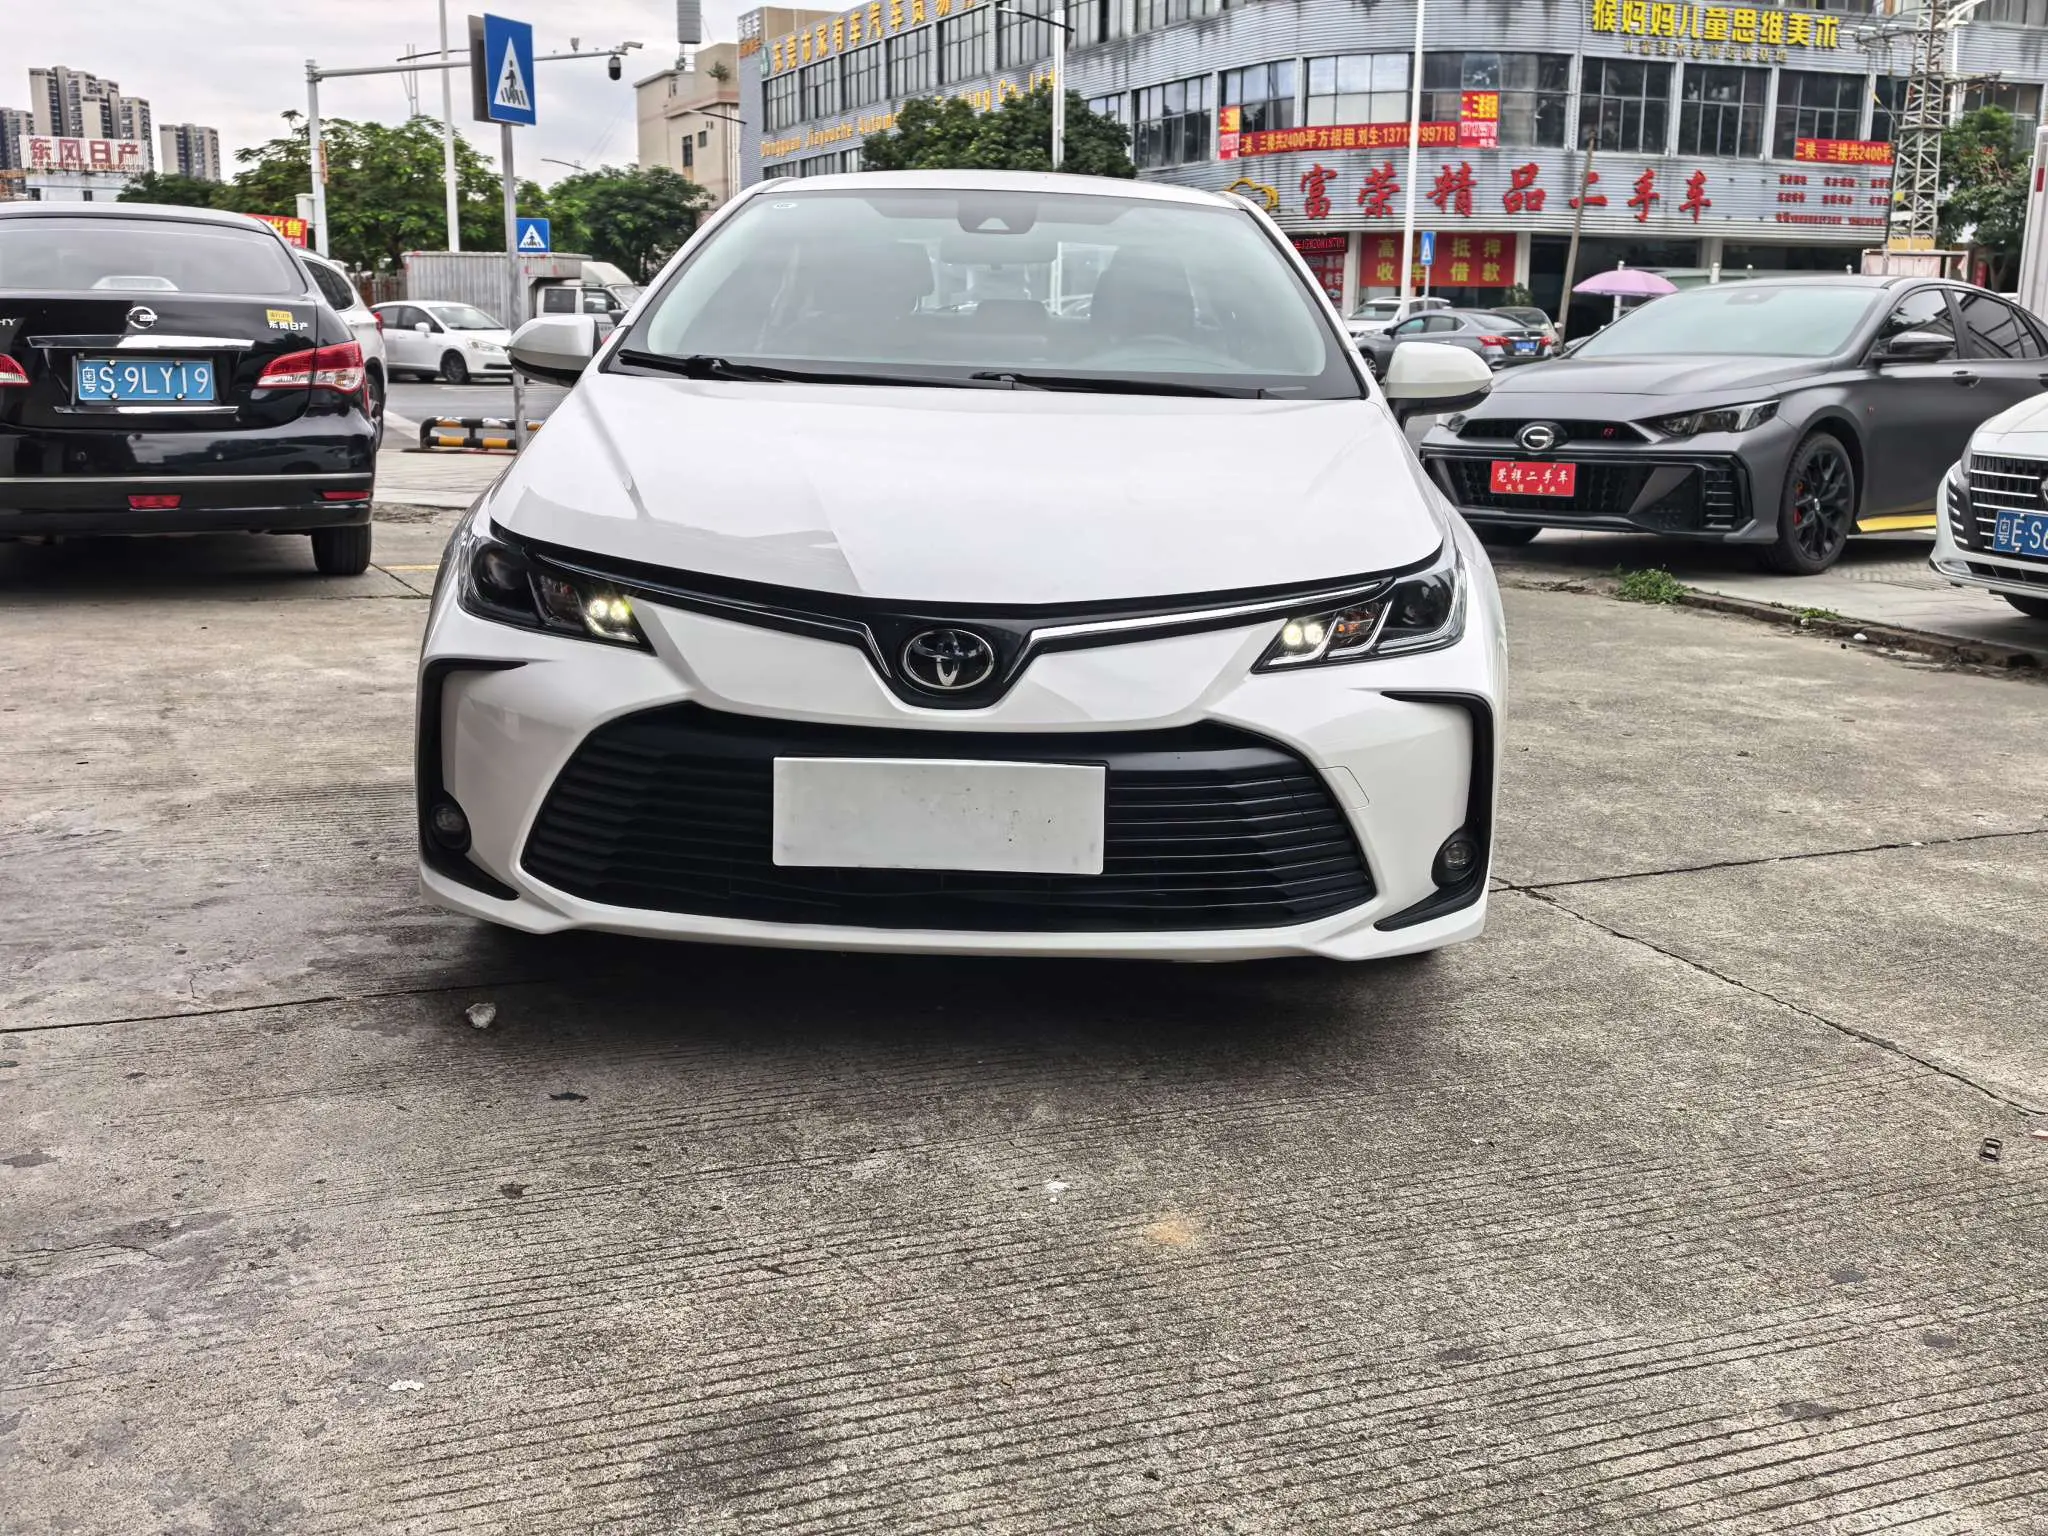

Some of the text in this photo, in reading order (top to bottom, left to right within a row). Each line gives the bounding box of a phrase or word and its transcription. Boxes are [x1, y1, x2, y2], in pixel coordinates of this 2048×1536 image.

[1592, 0, 1839, 48] 猴妈妈儿童思维美术
[1357, 126, 1457, 145] 刘生:137199718
[29, 138, 139, 165] 东风日产
[1301, 160, 1712, 223] 富荣精品二手车
[82, 366, 209, 393] 粤S·9LY19
